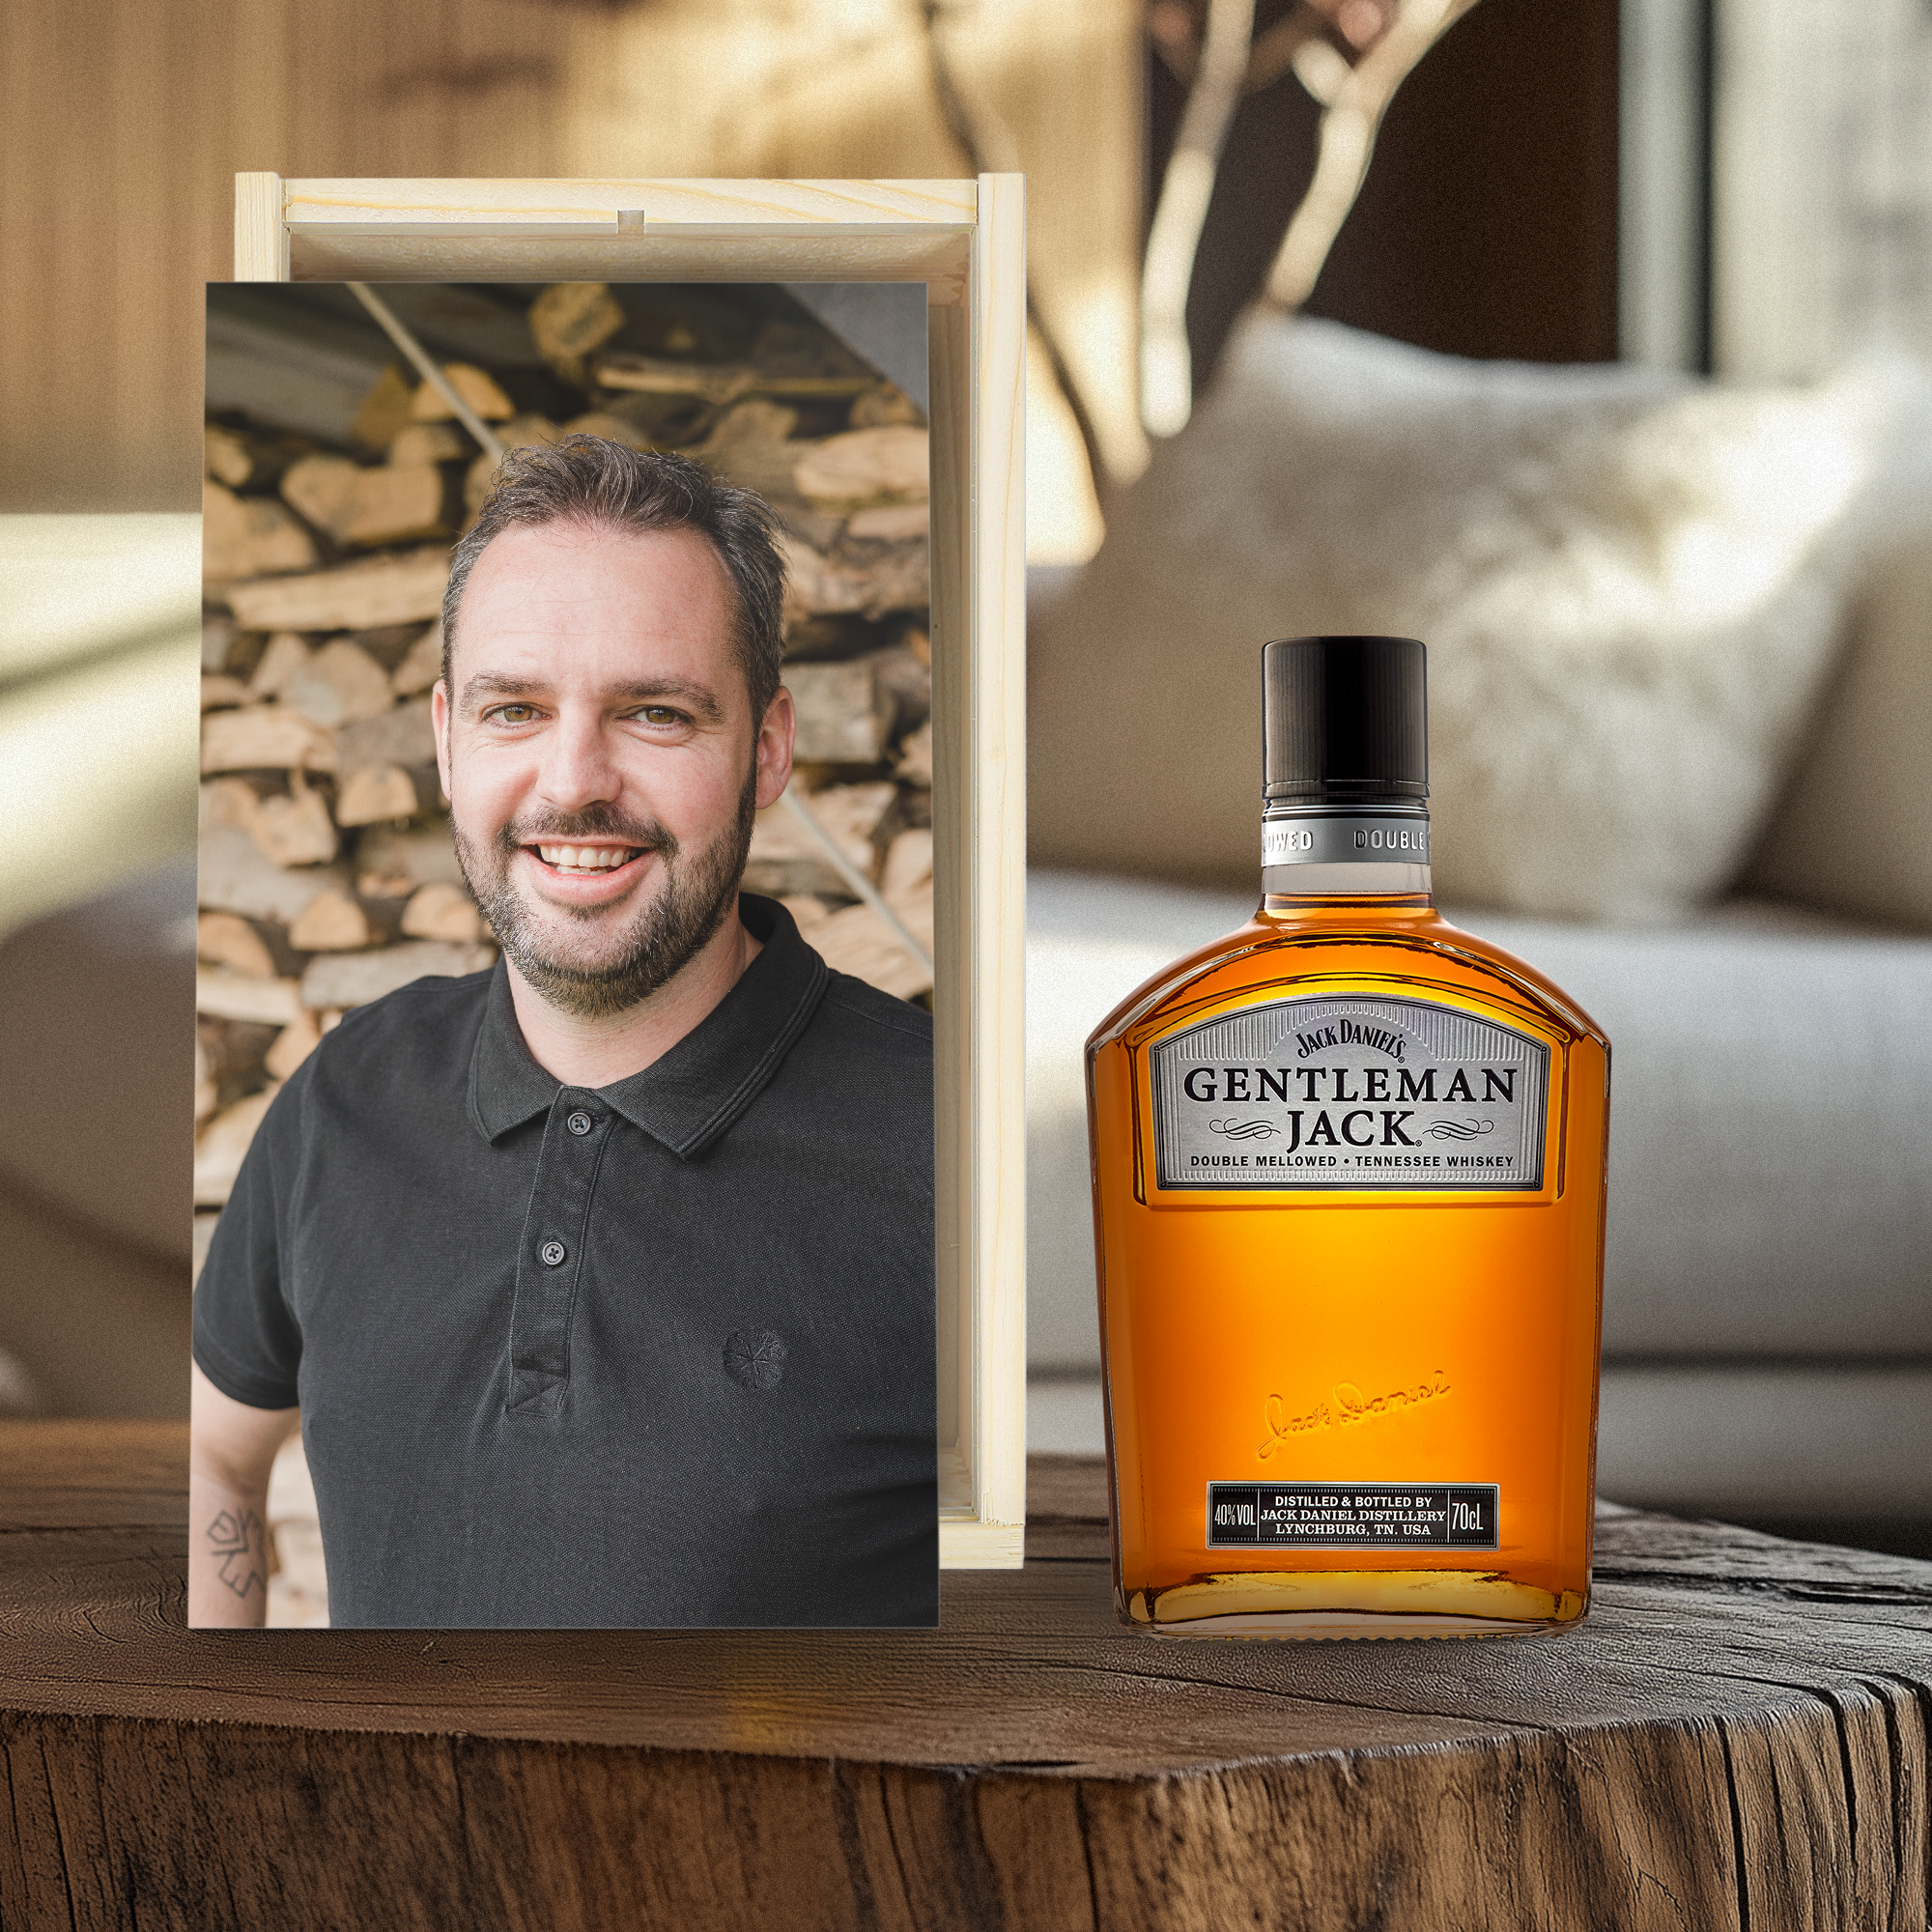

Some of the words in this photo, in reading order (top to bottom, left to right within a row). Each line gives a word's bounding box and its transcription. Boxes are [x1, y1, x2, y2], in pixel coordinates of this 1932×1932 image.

[1353, 829, 1425, 851] DOUBLE
[1295, 1026, 1340, 1059] JACK
[1182, 1066, 1518, 1103] GENTLEMAN
[1286, 1110, 1415, 1154] JACK
[1190, 1155, 1249, 1167] DOUBLE
[1255, 1155, 1337, 1167] MELLOWED
[1355, 1155, 1441, 1167] TENNESSEE
[1446, 1155, 1514, 1168] WHISKEY
[1275, 1495, 1339, 1507] DISTILLED
[1341, 1496, 1351, 1507] &
[1354, 1496, 1411, 1507] BOTTLED
[1415, 1496, 1432, 1507] BY
[1260, 1509, 1297, 1520] JACK
[1299, 1510, 1356, 1521] DANIEL
[1358, 1510, 1447, 1521] DISTILLERY
[1275, 1523, 1370, 1536] LYNCHBURG,
[1374, 1524, 1398, 1535] TN.
[1403, 1524, 1431, 1535] USA
